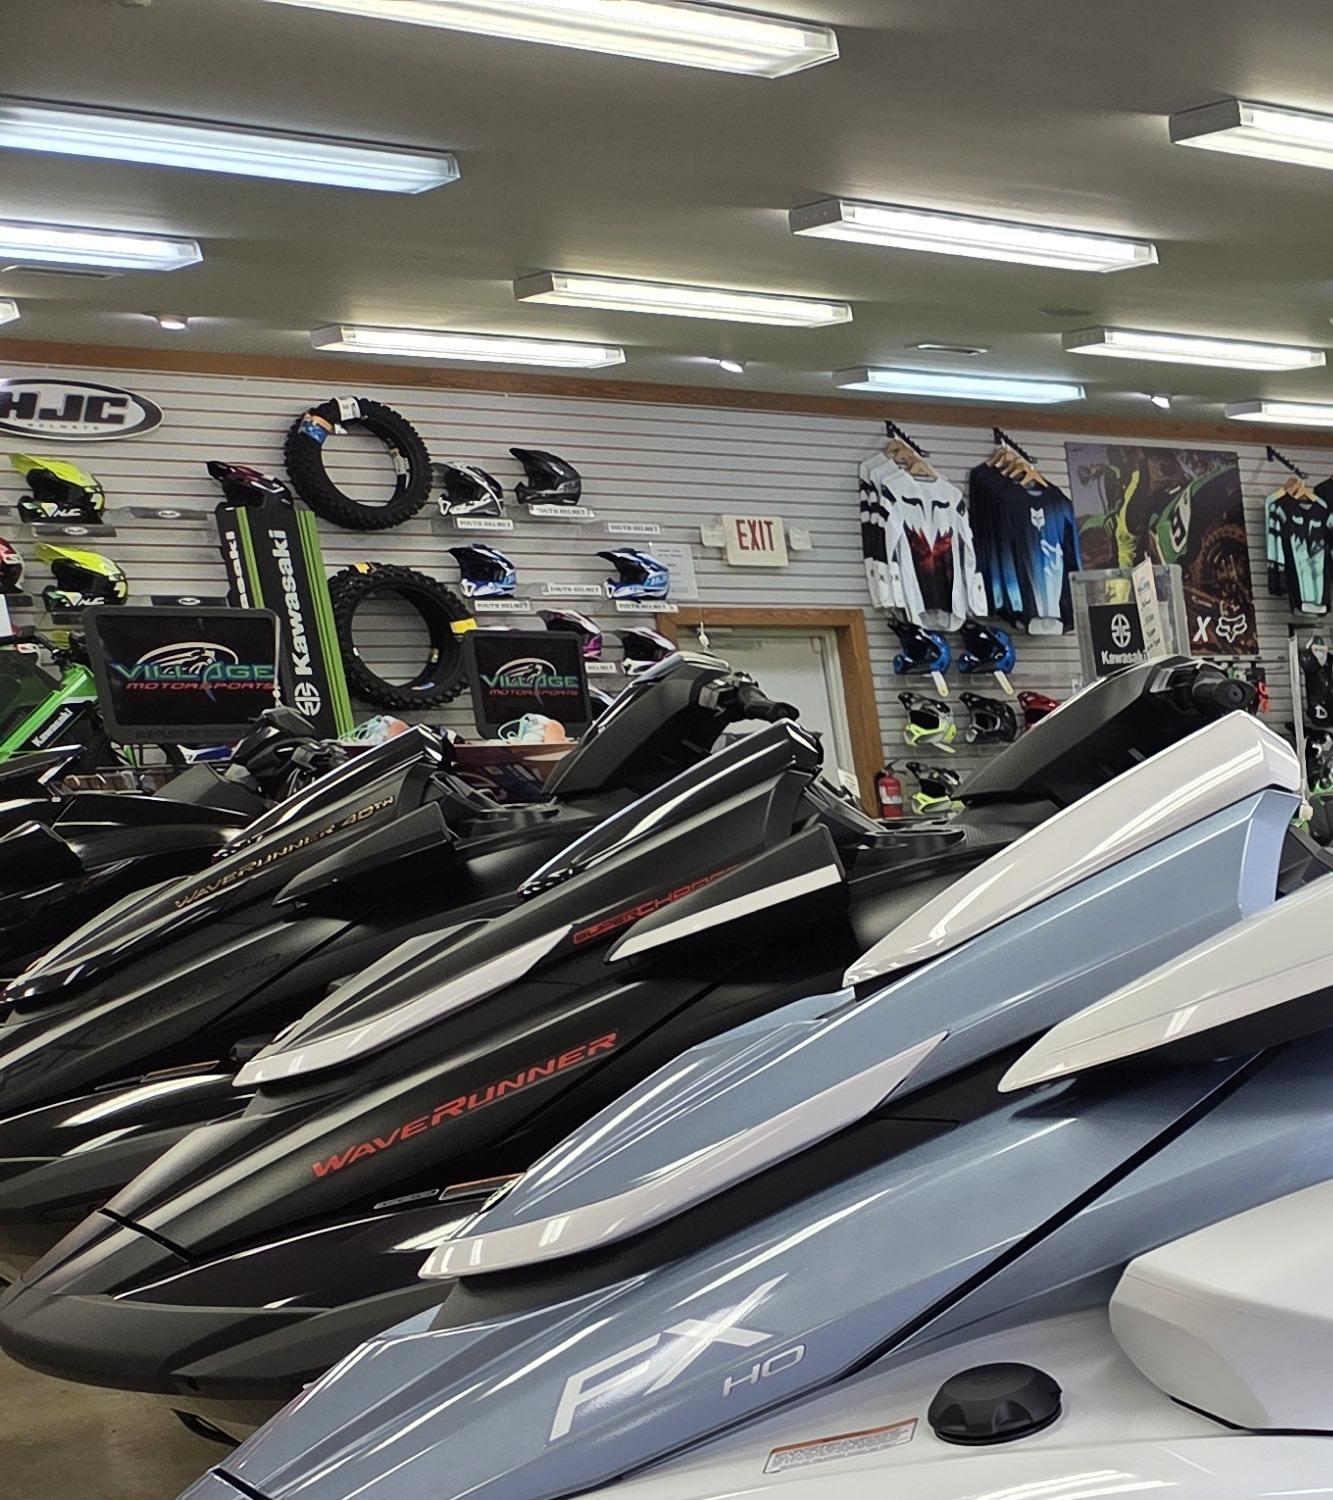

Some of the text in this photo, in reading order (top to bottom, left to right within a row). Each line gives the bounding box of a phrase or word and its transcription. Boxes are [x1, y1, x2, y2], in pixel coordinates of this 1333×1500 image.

[0, 392, 129, 424] HJC
[735, 519, 774, 551] EXIT
[268, 529, 313, 676] Kawasaki
[110, 662, 276, 681] VILLAGE
[126, 682, 277, 690] MOTORSPORTS
[480, 675, 579, 688] VILLAGE
[312, 1032, 619, 1178] WAVERUNNER
[549, 1272, 789, 1442] FX
[722, 1344, 806, 1398] HO
